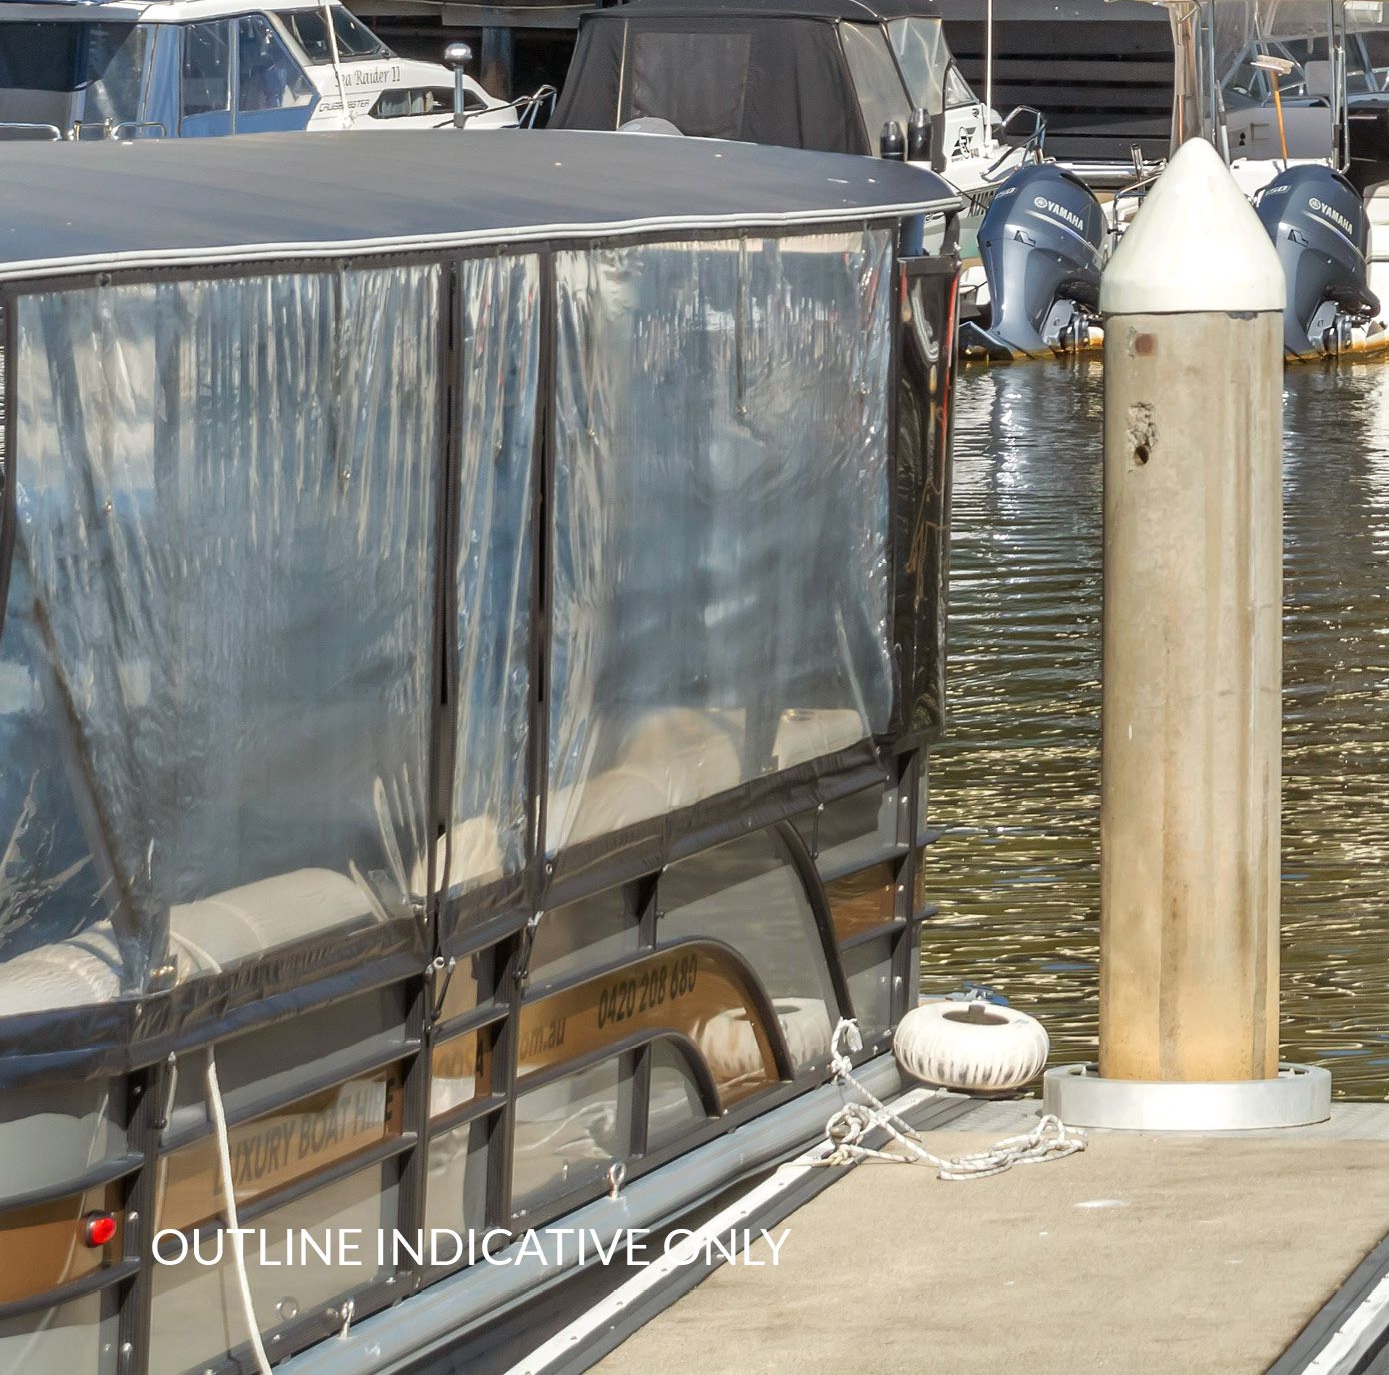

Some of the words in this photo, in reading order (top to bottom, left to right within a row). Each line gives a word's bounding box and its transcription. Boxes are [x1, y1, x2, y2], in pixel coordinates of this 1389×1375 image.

[354, 67, 389, 86] Raider
[1046, 200, 1084, 231] YAMAHA
[1321, 202, 1353, 235] YAMAHA
[597, 979, 636, 1030] 0420
[637, 972, 666, 1014] 208
[669, 954, 698, 1001] 680
